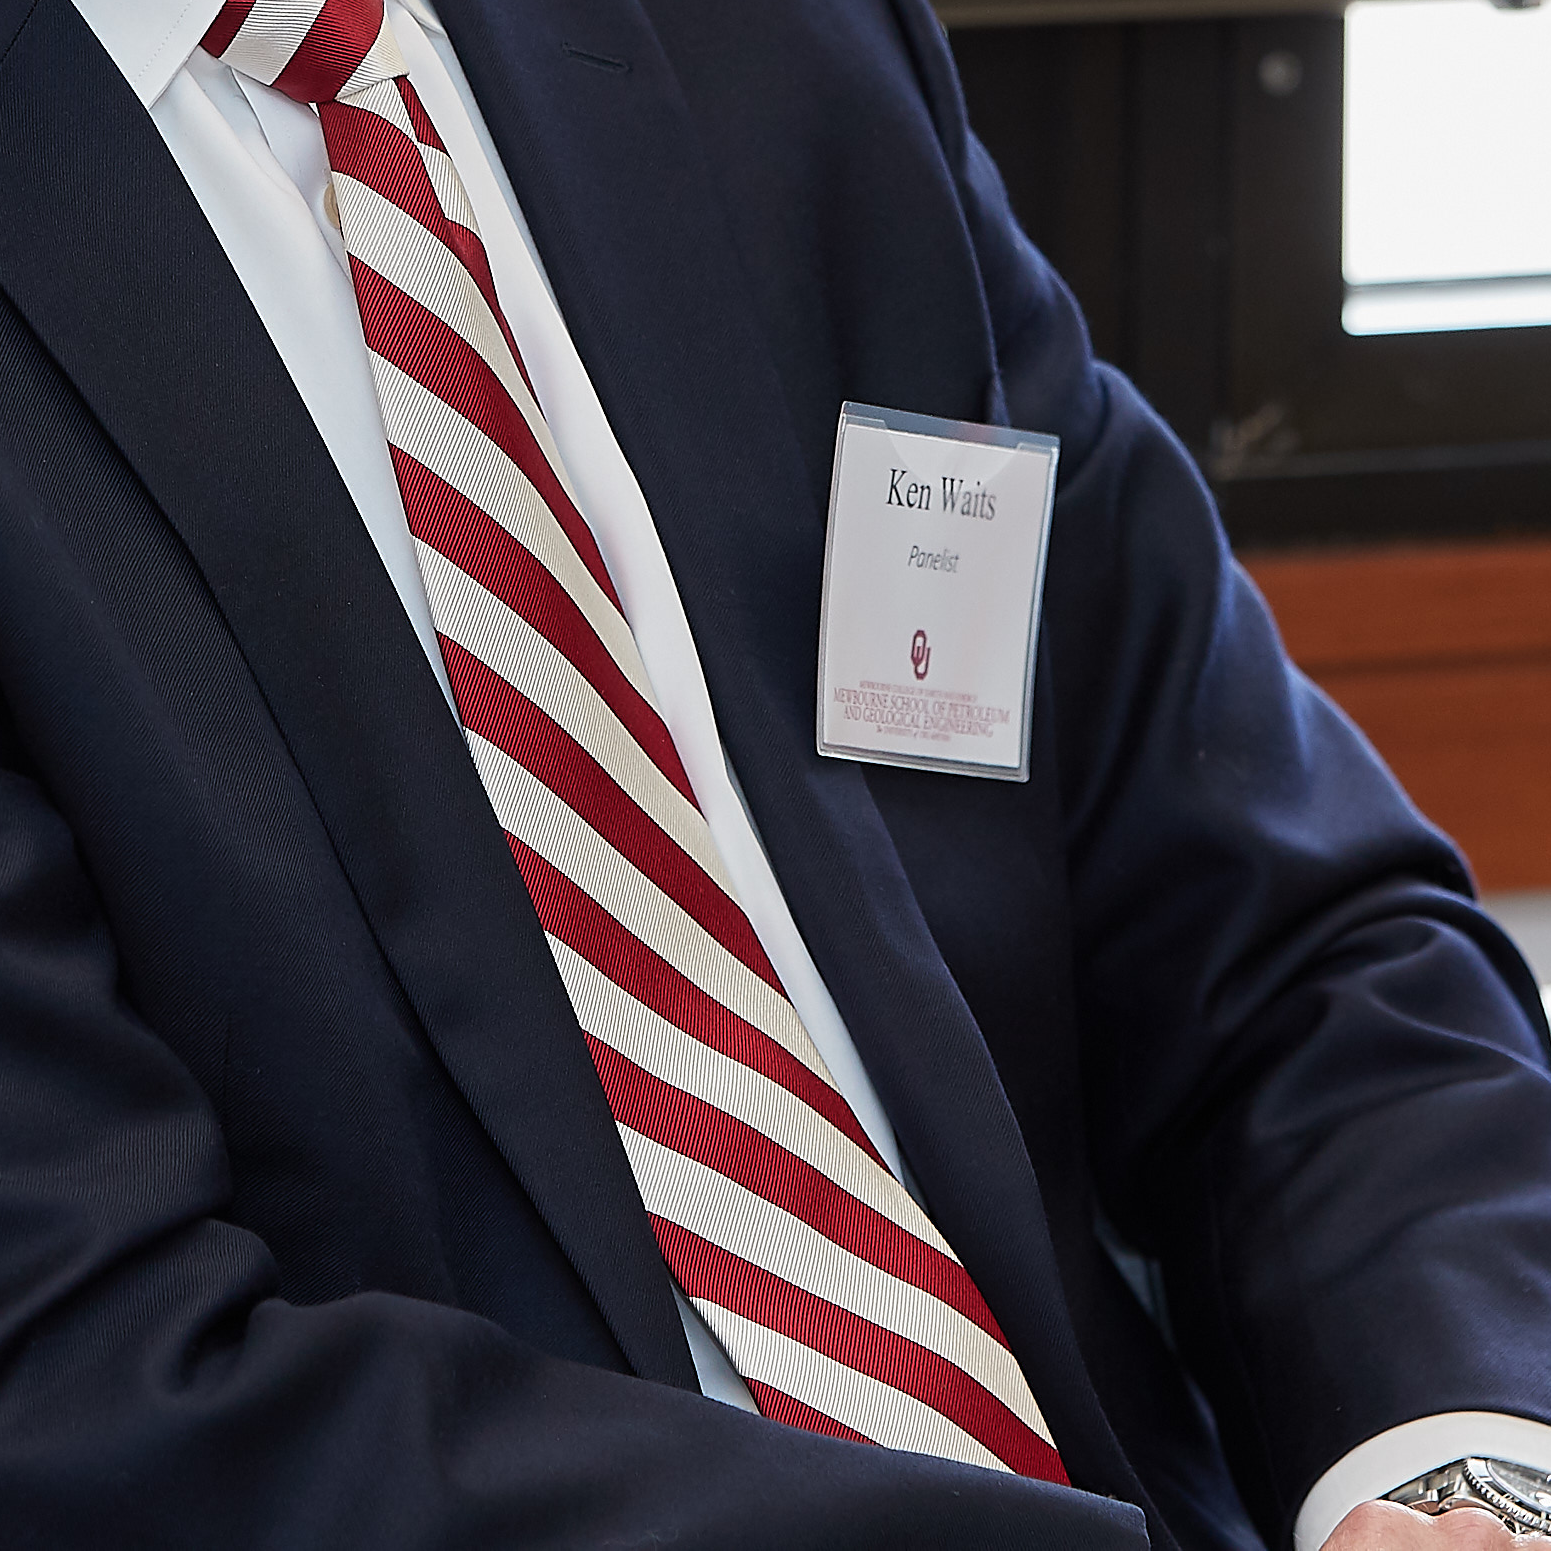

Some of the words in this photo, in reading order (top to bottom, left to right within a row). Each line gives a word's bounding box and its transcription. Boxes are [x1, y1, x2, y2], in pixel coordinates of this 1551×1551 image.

[886, 468, 931, 511] Ken
[940, 476, 997, 522] Waits
[907, 545, 959, 573] Panelist
[844, 706, 861, 721] AND
[863, 707, 921, 728] GEOLOGICAL
[924, 715, 993, 738] ENGINEERING
[890, 694, 929, 714] SCHOOL
[932, 701, 946, 716] OF
[947, 702, 1010, 724] PETROLEUM
